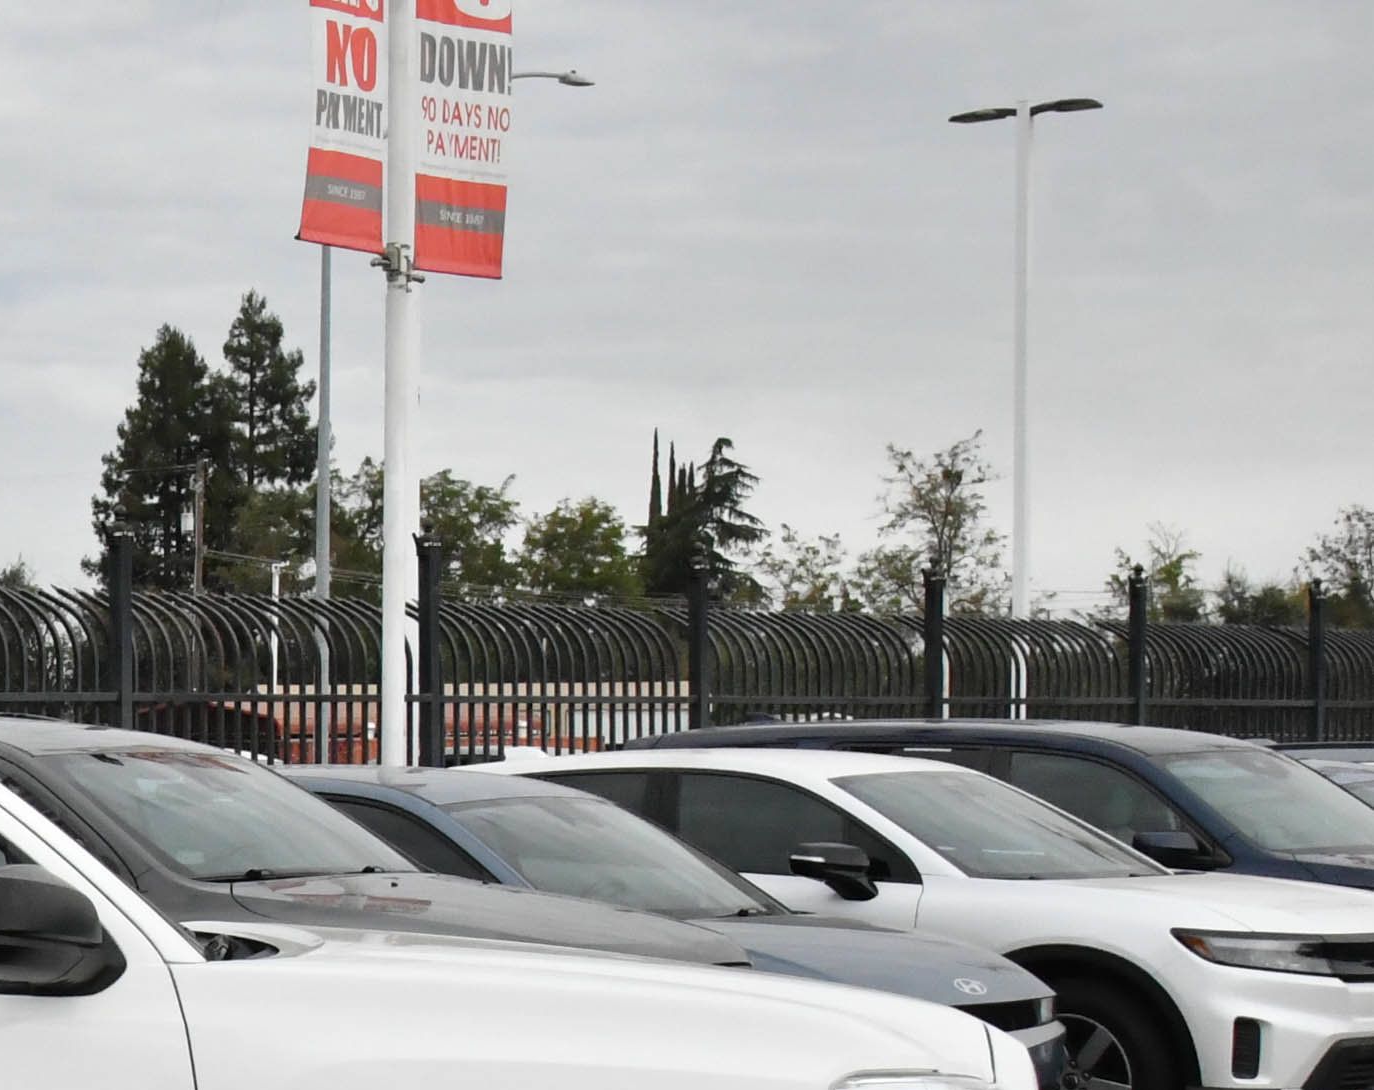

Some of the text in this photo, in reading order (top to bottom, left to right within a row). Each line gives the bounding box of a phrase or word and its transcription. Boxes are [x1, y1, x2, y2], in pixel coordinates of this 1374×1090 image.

[326, 19, 377, 92] NO
[420, 32, 512, 96] DOWN!
[421, 96, 511, 132] 90 DAYS NO
[426, 129, 501, 164] PAYMENT!
